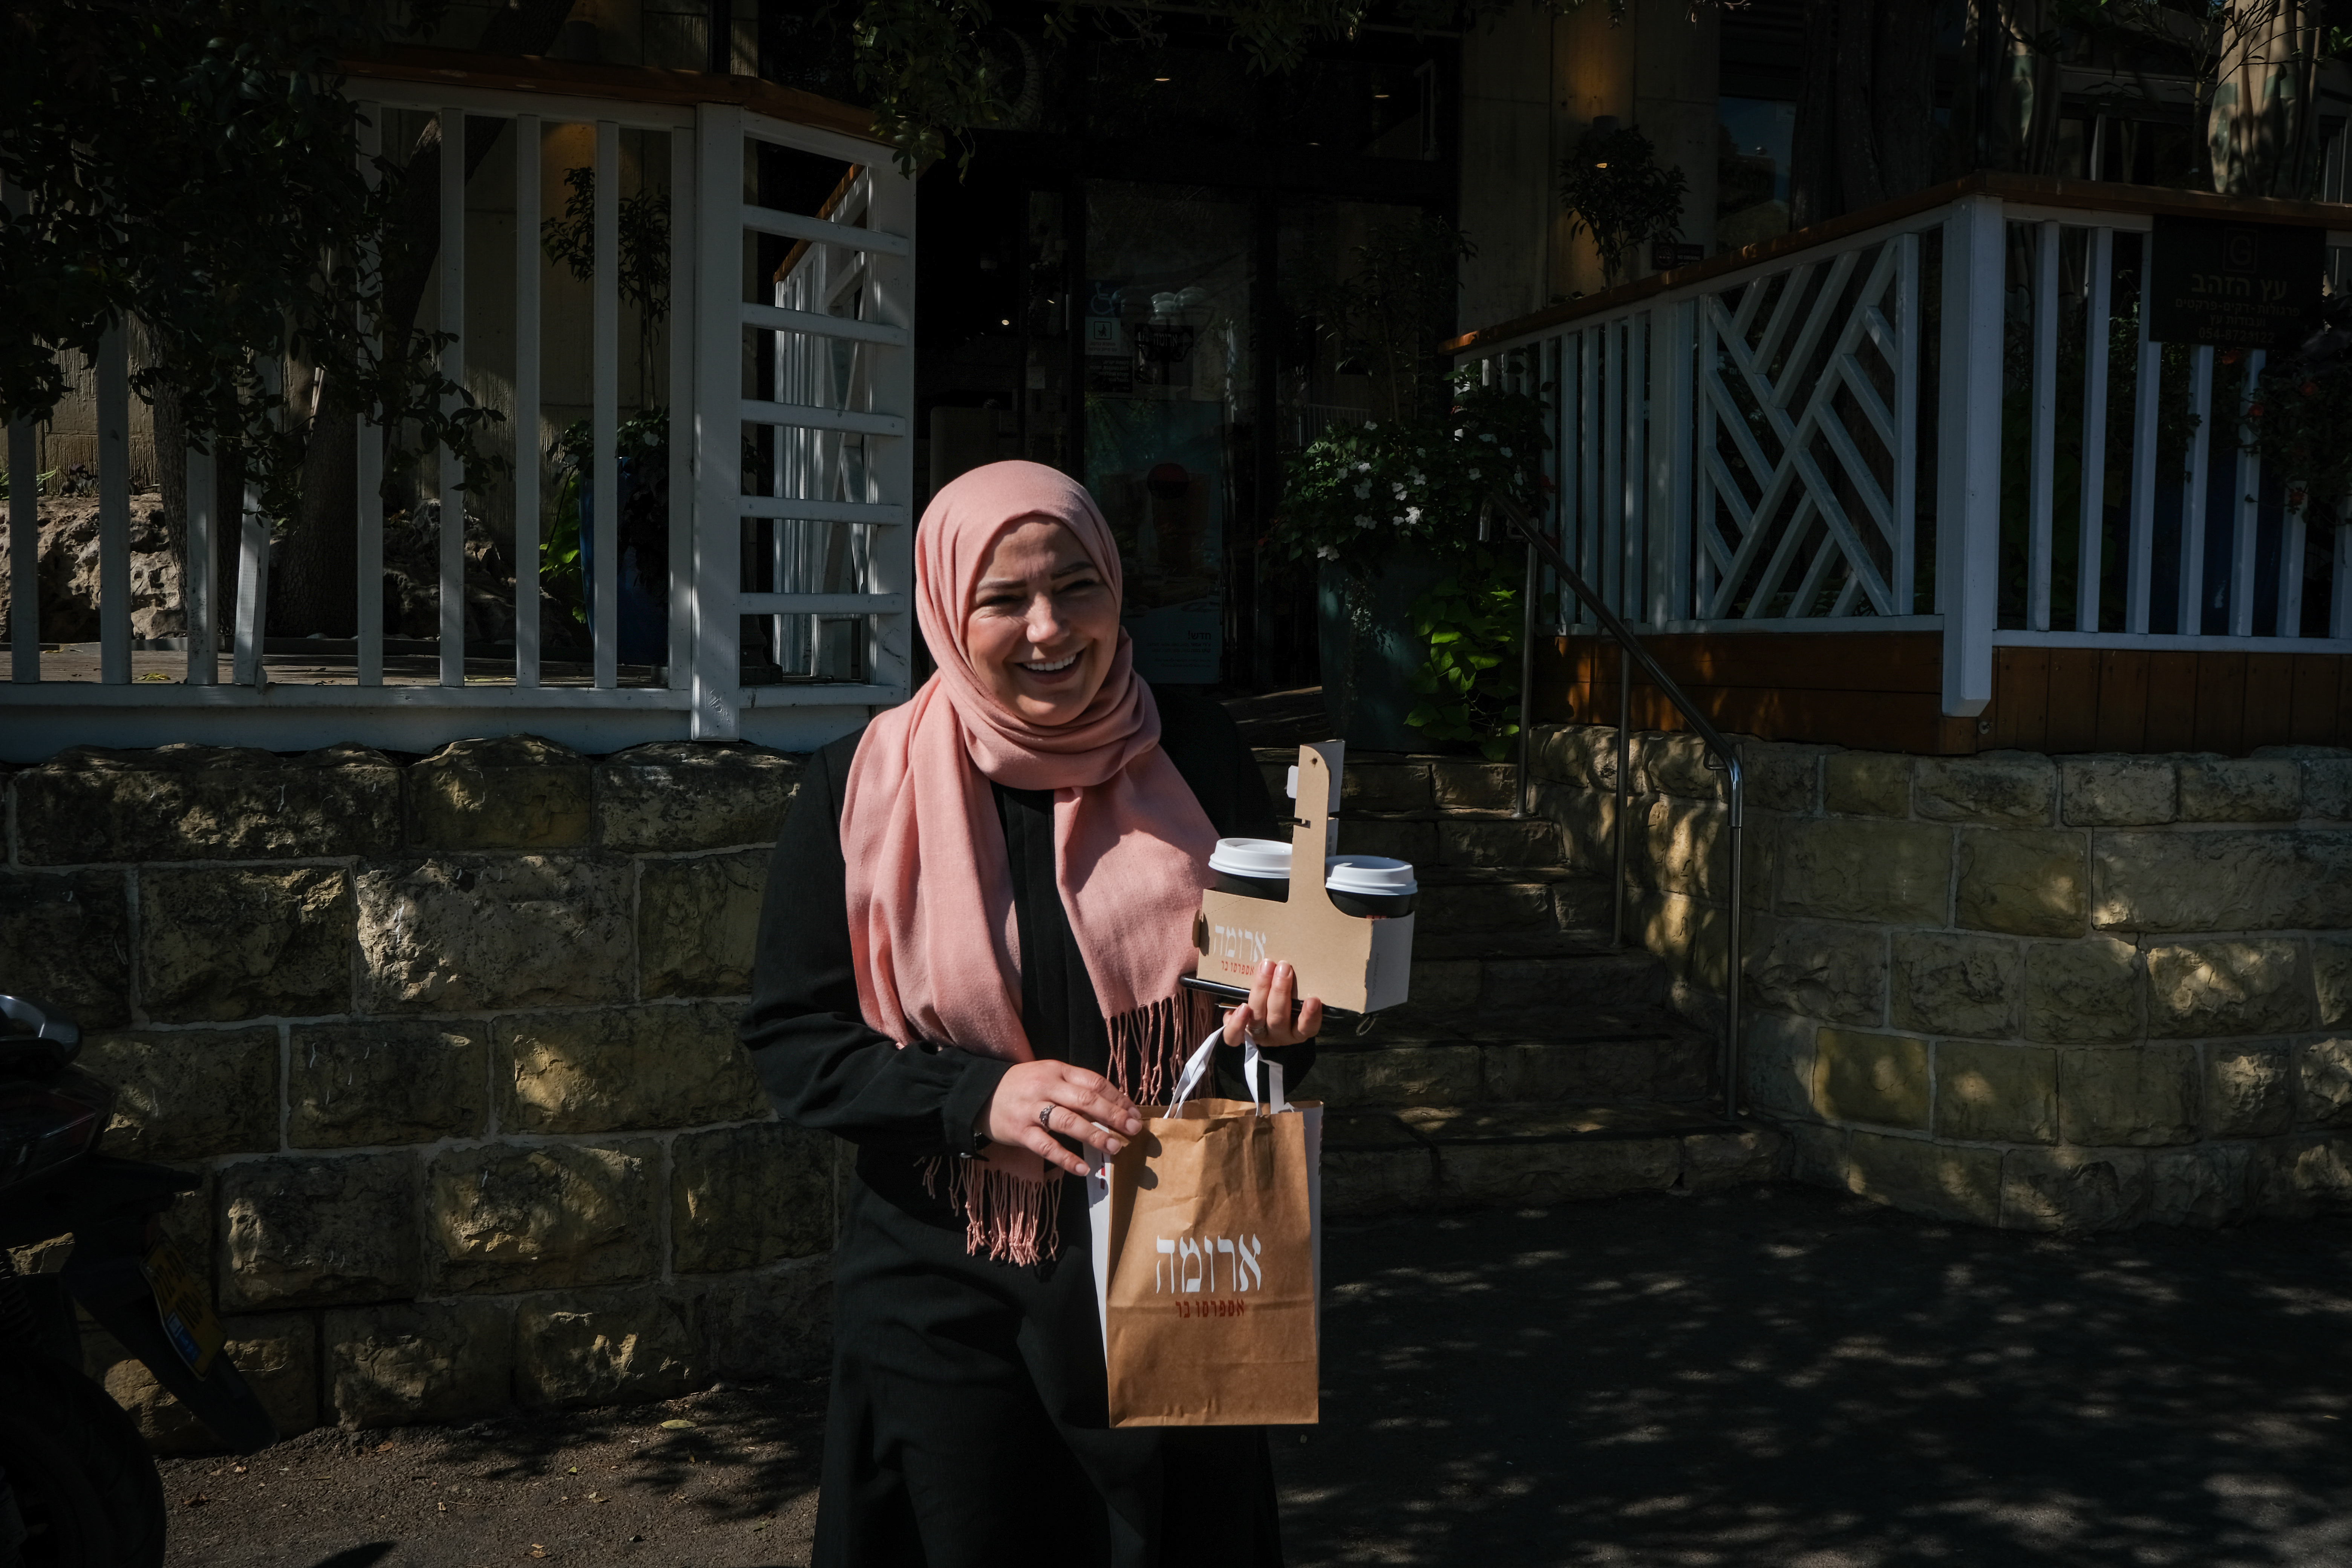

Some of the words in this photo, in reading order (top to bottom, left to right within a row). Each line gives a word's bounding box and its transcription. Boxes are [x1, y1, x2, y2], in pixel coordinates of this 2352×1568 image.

[2229, 235, 2251, 266] G
[2191, 273, 2251, 297] הזהב
[2259, 278, 2287, 302] עץ
[2210, 314, 2222, 326] עץ
[2226, 314, 2266, 327] ועבודות
[1153, 332, 1178, 347] ארומה
[1188, 630, 1211, 640] חדש!
[1213, 923, 1266, 963] ארומה
[1221, 960, 1228, 971] בר
[1231, 962, 1254, 976] אספרסו
[1156, 1233, 1261, 1294] ארומה
[176, 1291, 203, 1329] 103
[1176, 1300, 1190, 1318] בר
[1196, 1298, 1245, 1317] אספרסו
